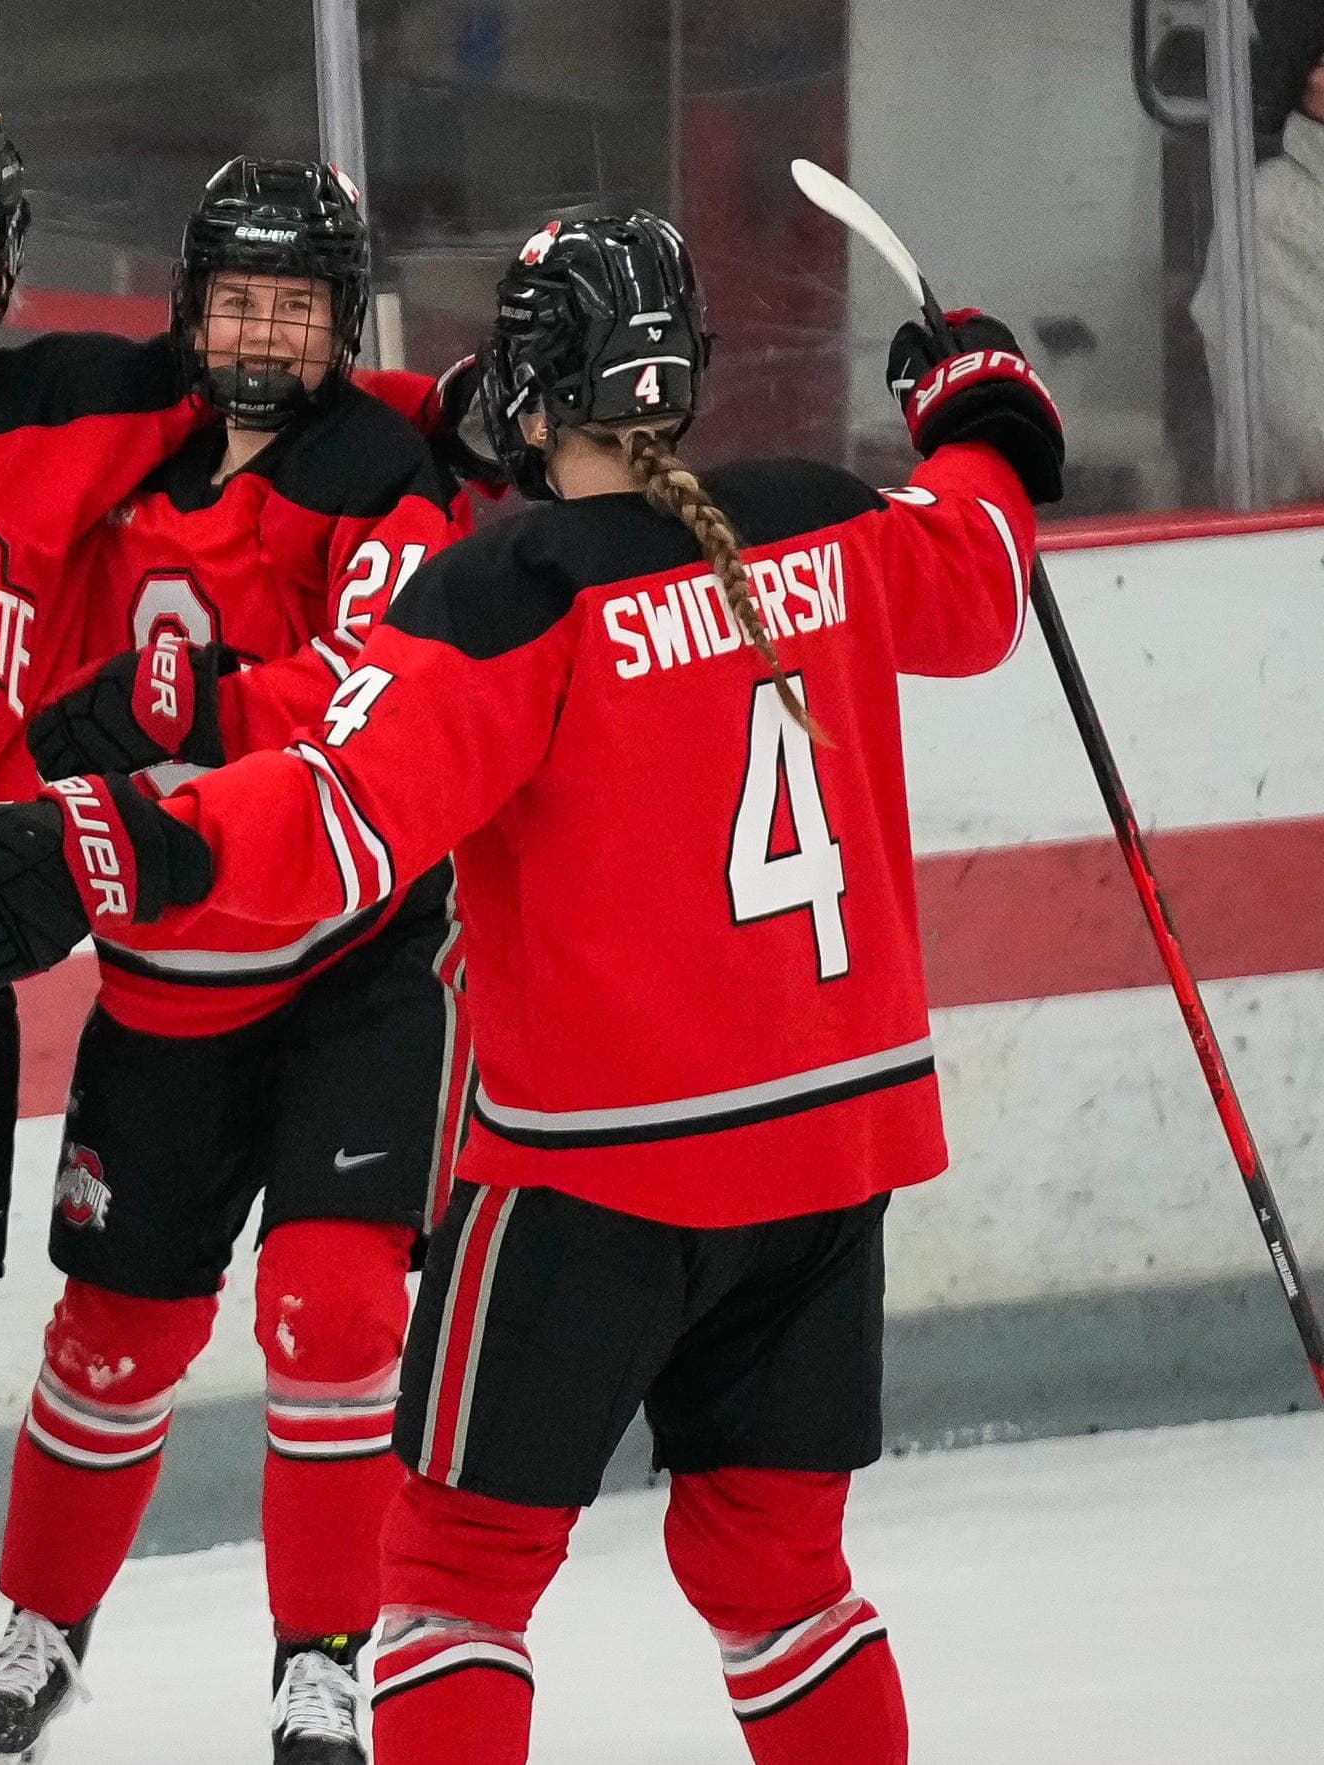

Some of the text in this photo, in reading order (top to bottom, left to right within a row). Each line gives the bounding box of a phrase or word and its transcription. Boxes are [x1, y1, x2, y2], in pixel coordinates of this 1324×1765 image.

[234, 226, 298, 243] BAUER
[635, 364, 660, 405] 4
[323, 663, 396, 748] 4
[47, 776, 129, 917] AUER
[726, 670, 850, 983] 4
